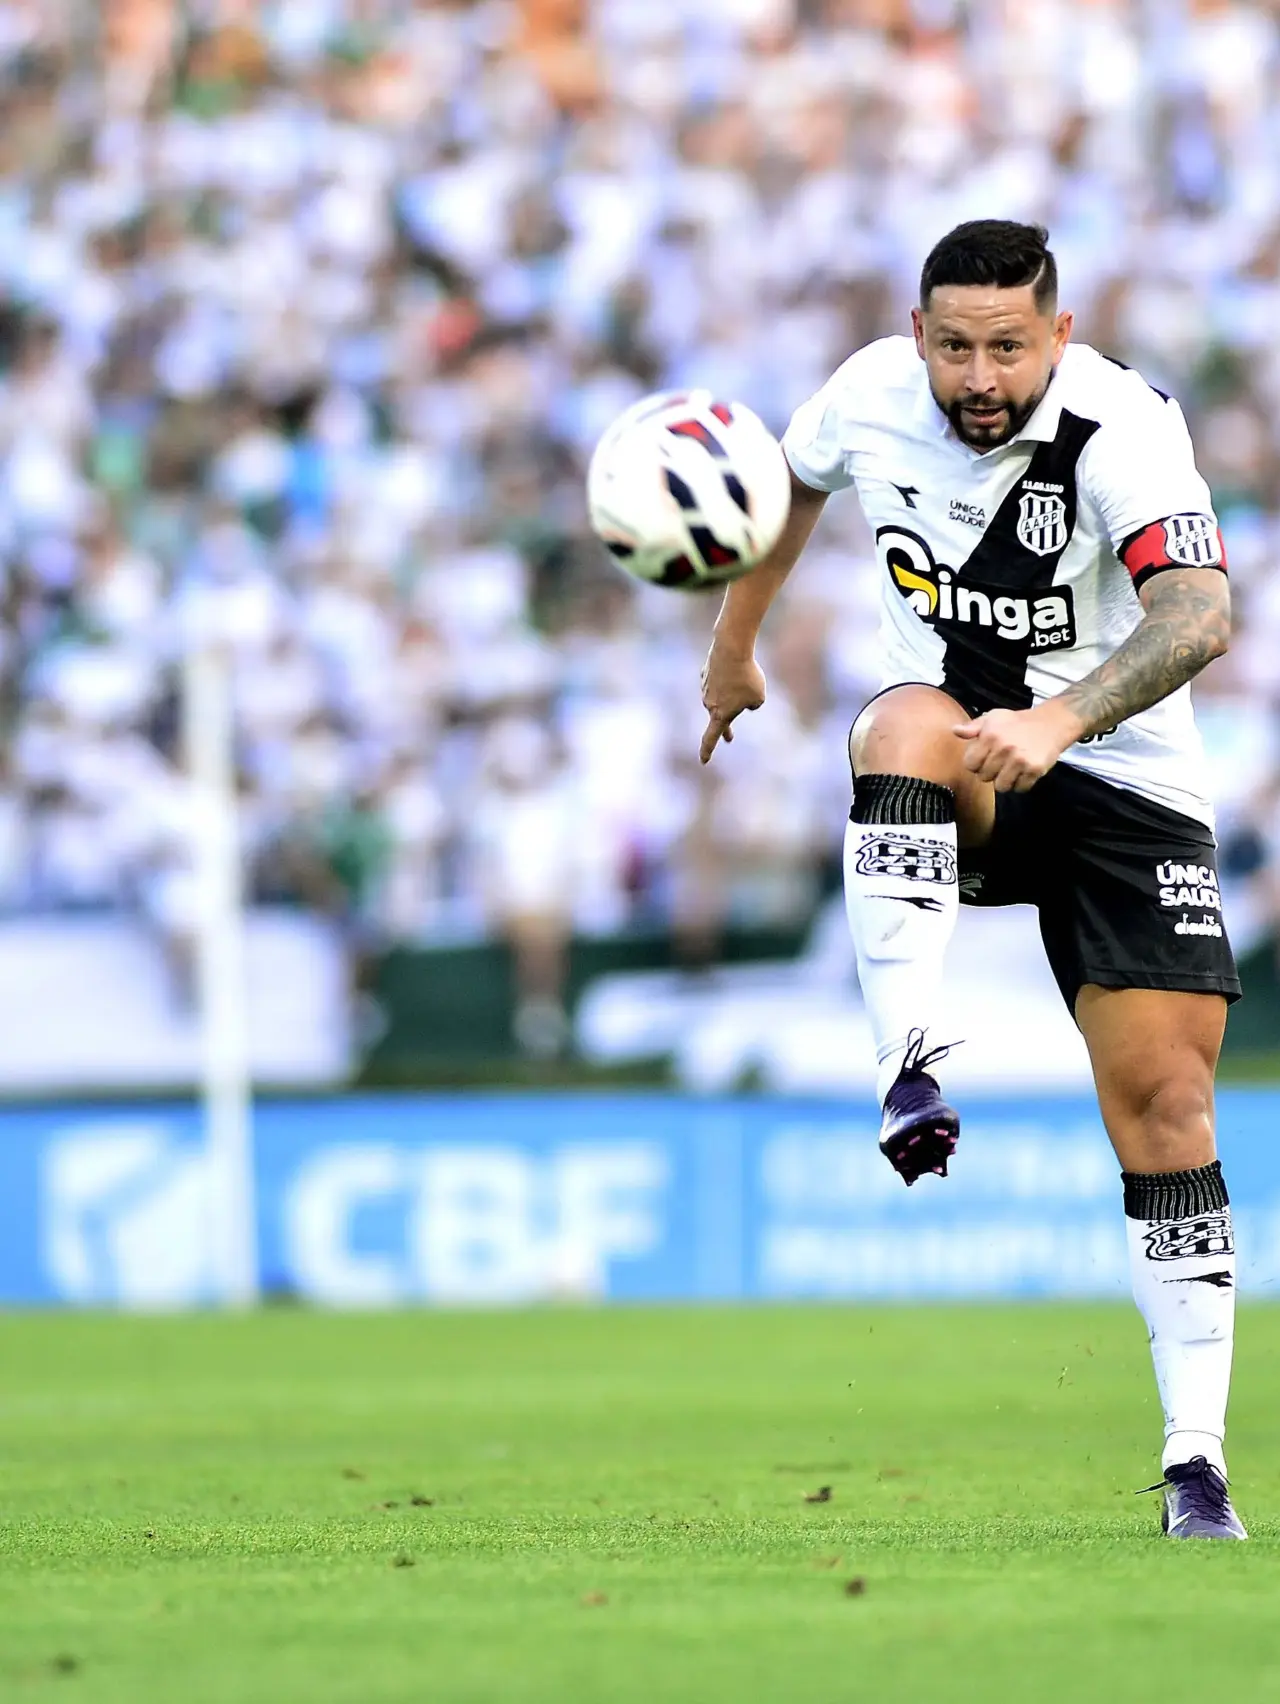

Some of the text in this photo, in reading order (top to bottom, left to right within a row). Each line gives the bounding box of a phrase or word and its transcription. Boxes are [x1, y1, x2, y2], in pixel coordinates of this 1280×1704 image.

[1024, 512, 1058, 532] AAPP
[1156, 860, 1219, 891] ÚNICA
[285, 1142, 668, 1308] CBF
